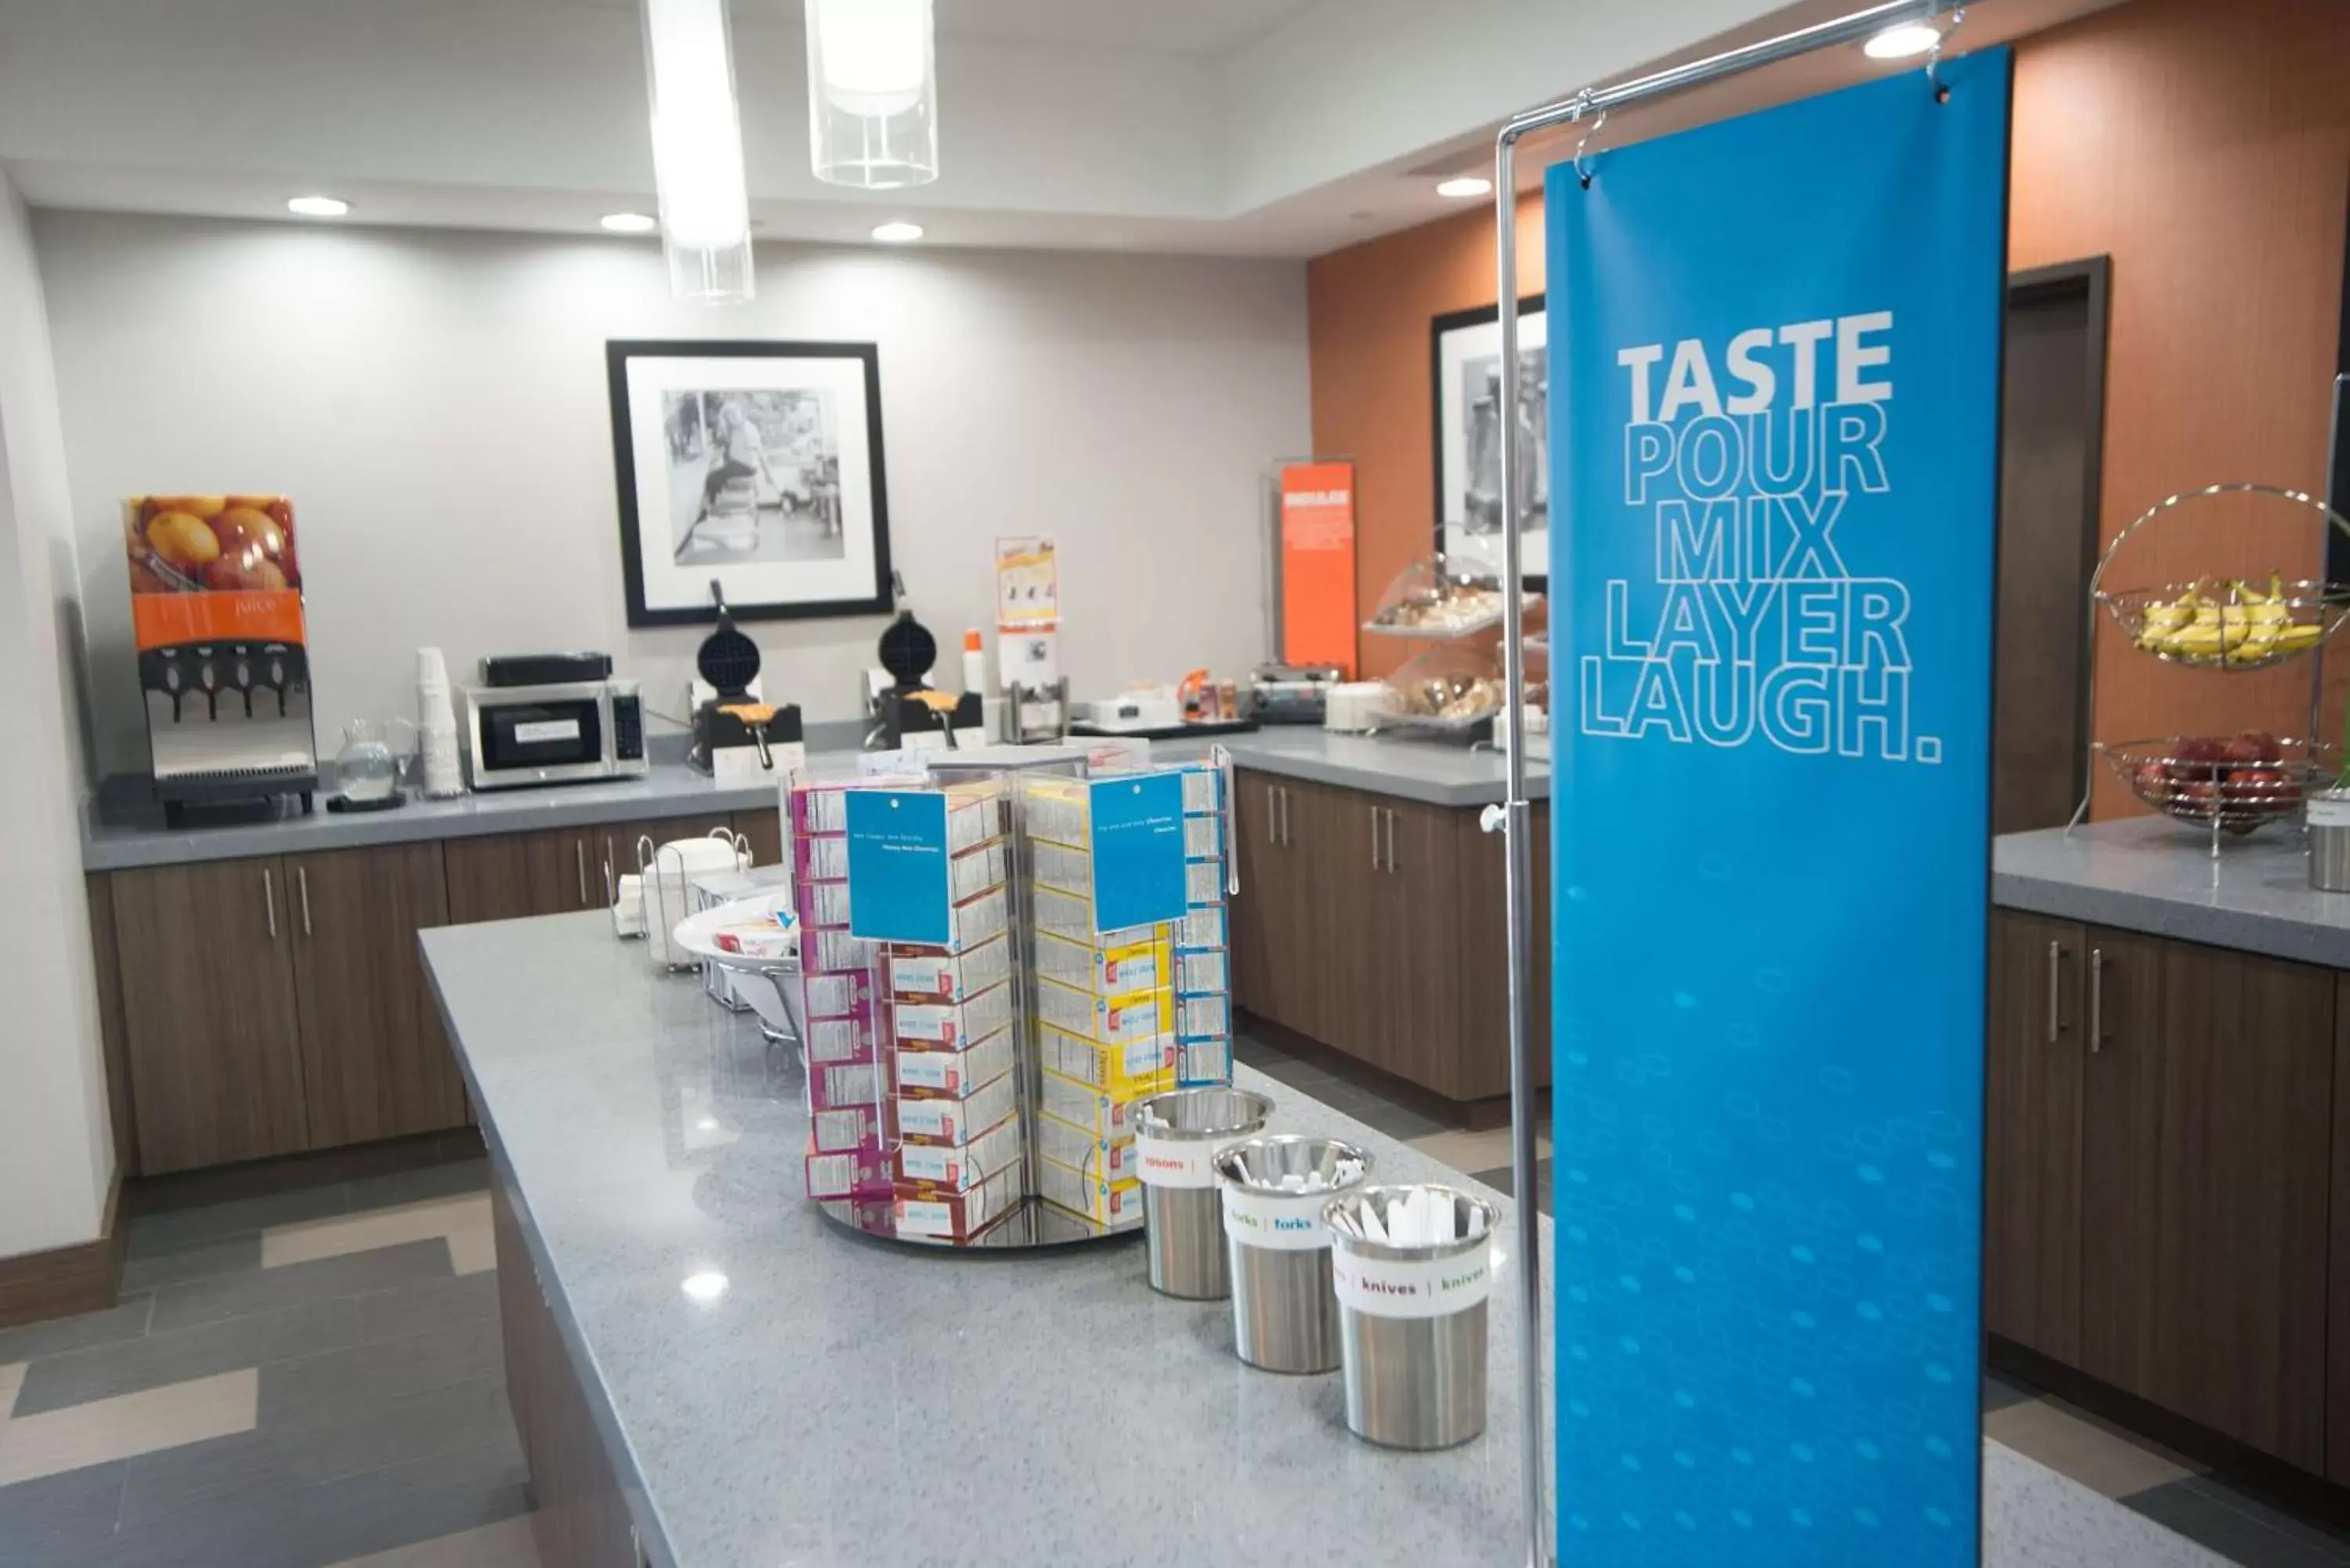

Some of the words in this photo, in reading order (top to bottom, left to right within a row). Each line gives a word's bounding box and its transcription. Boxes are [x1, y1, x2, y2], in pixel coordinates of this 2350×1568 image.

[1618, 311, 1893, 423] TASTE
[1625, 401, 1890, 504] POUR
[1656, 491, 1849, 583] MIX
[1607, 578, 1913, 671] LAYER
[1581, 656, 1942, 764] LAUGH.
[1274, 1216, 1311, 1230] forks
[1361, 1277, 1417, 1295] knives
[1441, 1266, 1484, 1291] knives
